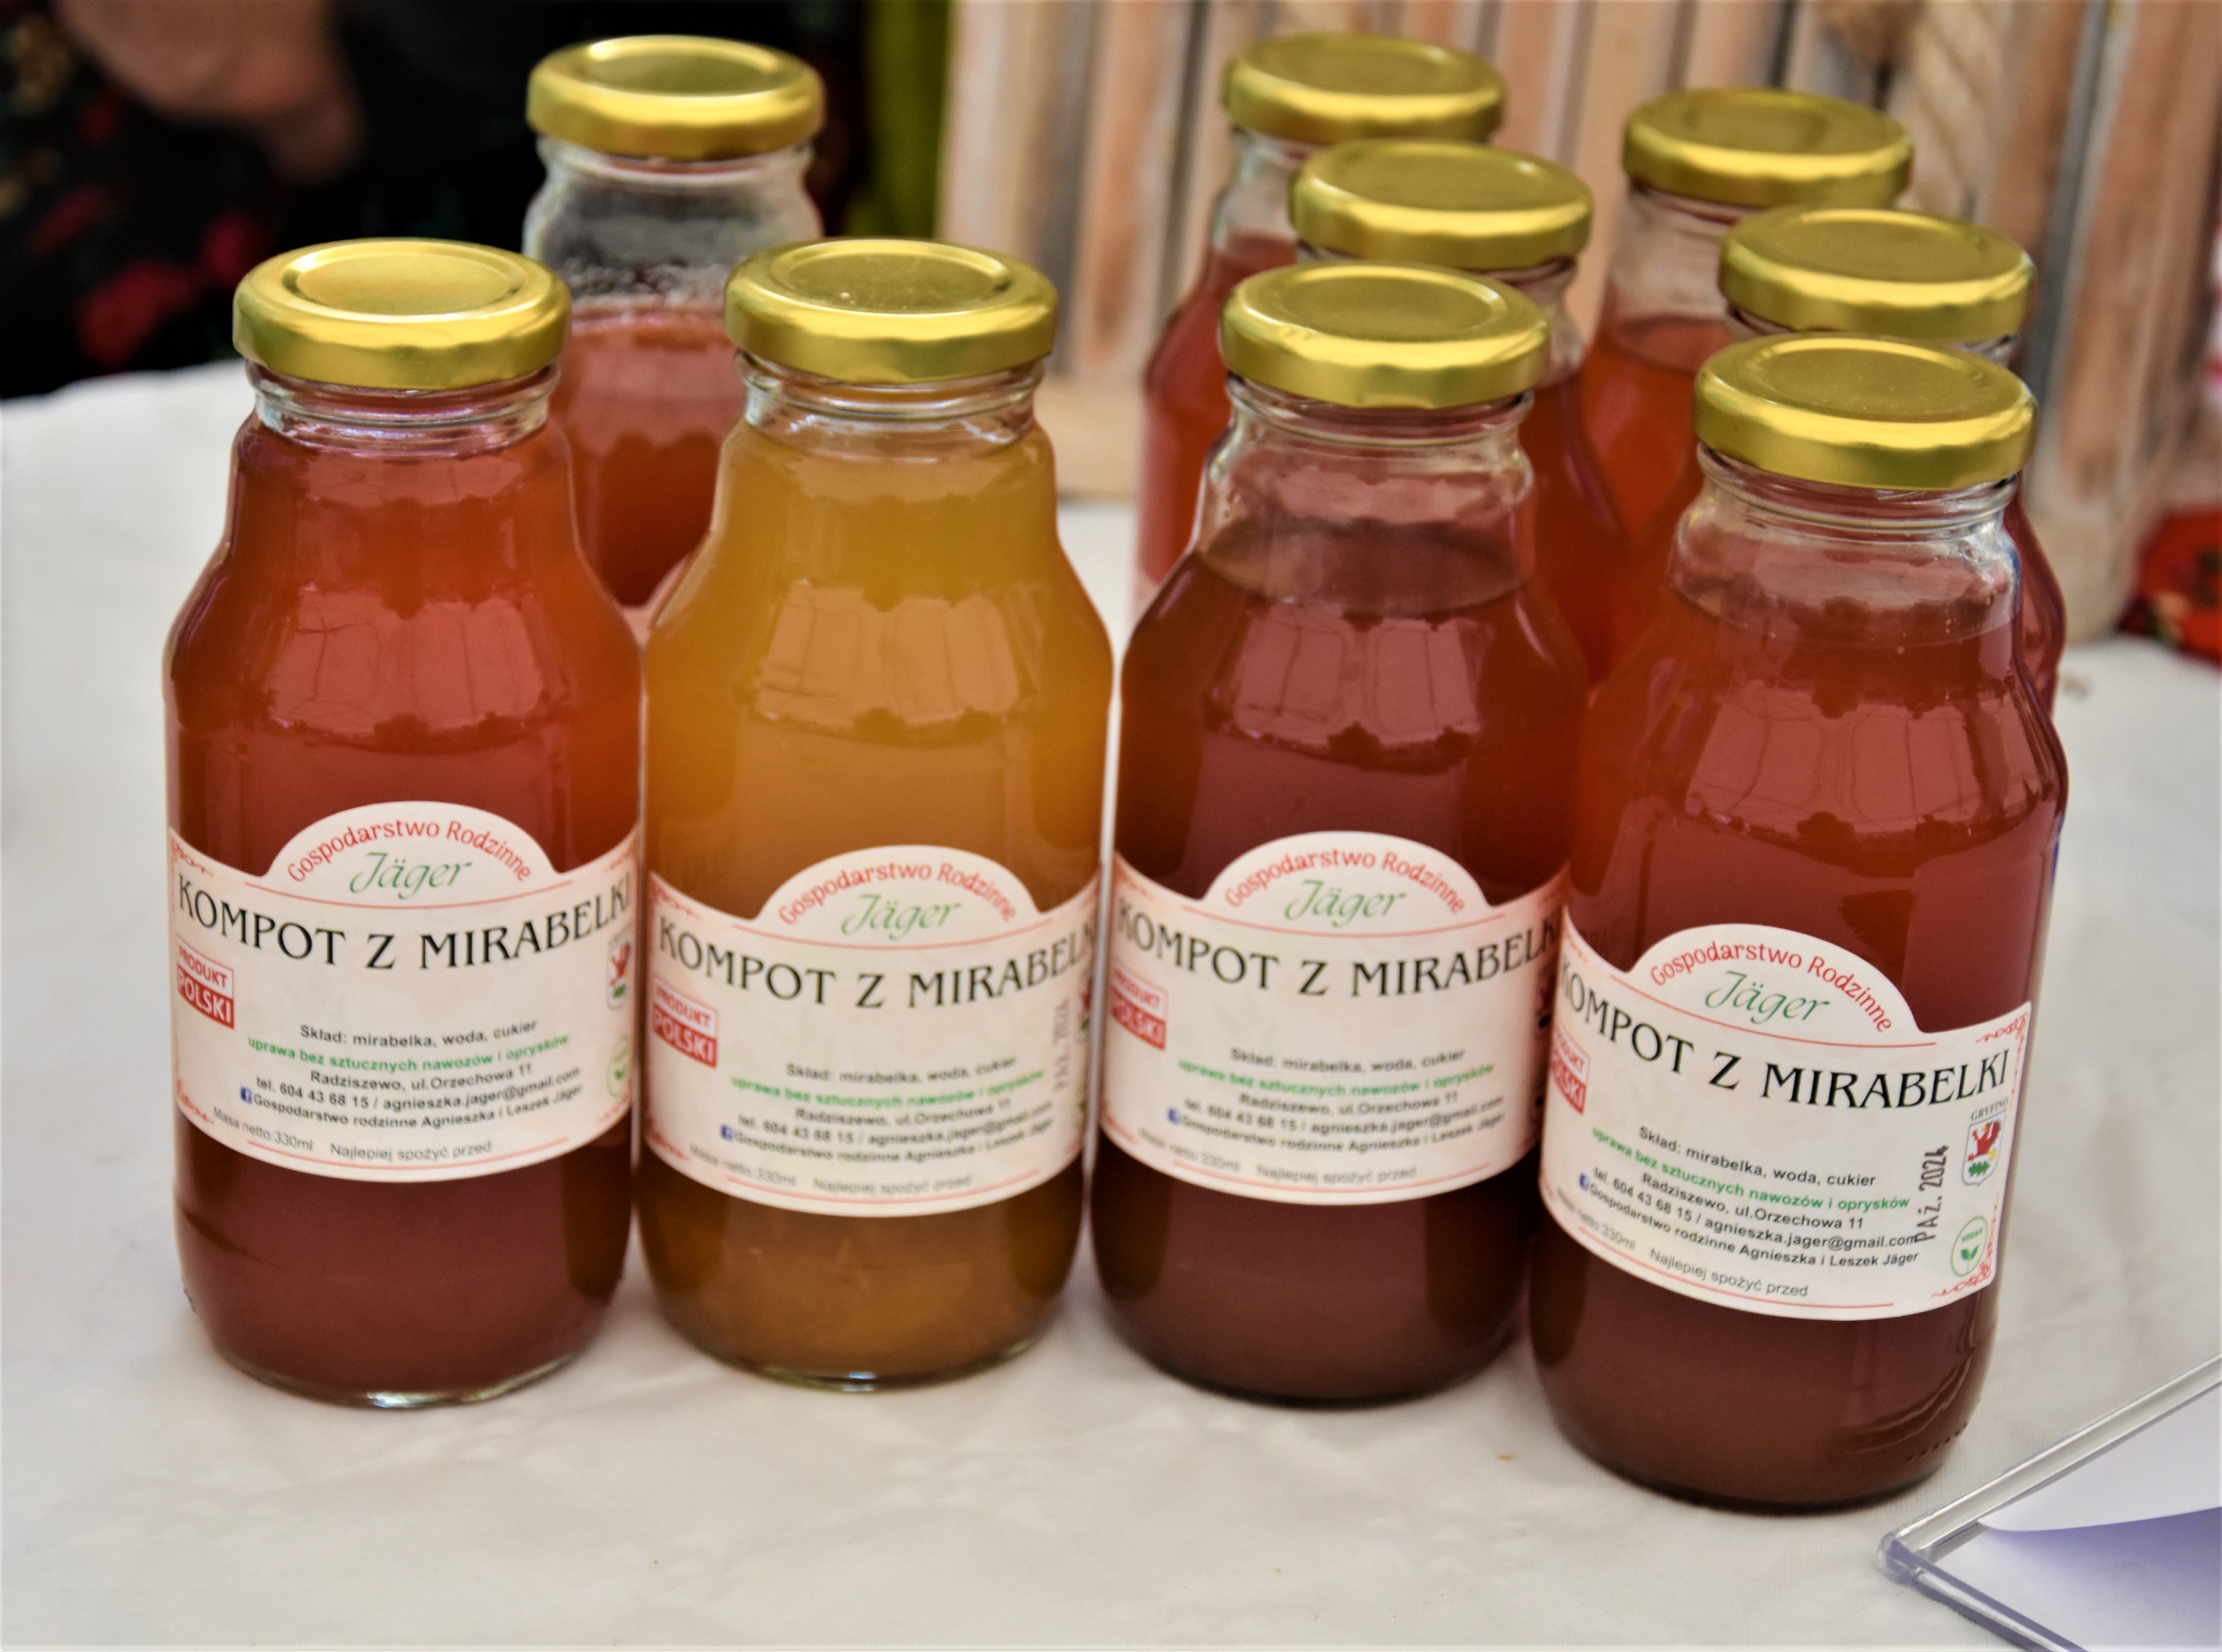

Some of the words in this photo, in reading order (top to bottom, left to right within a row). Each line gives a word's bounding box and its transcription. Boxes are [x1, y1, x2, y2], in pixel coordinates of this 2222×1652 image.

[287, 820, 439, 882] Gospodarstwo
[446, 820, 531, 881] Rodzinne
[349, 852, 472, 900] Jäger
[779, 862, 933, 925] Gospodarstwo
[937, 862, 1017, 922] Rodzinne
[1224, 848, 1376, 907] Gospodarstwo
[1382, 851, 1466, 914] Rodzinne
[1284, 879, 1407, 928] Jäger
[179, 874, 345, 965] KOMPOT
[365, 933, 397, 969] Z
[420, 871, 630, 970] MIRABELKI
[841, 893, 961, 940] Jäger
[179, 945, 228, 988] PRODUKT
[660, 916, 836, 1005] KOMPOT
[855, 972, 886, 1009] Z
[1118, 898, 1280, 990] KOMPOT
[1298, 960, 1329, 996] Z
[178, 968, 231, 1024] POLSKI
[1651, 941, 1802, 986] Gospodarstwo
[1807, 955, 1891, 1032] Rodzinne
[1705, 970, 1830, 1024] Jäger
[248, 1038, 296, 1058] uprawa
[300, 1049, 325, 1065] bez
[329, 1057, 417, 1073] sztucznych
[423, 1054, 493, 1071] nawozów
[497, 1050, 502, 1061] i
[505, 1035, 569, 1060] oprysków
[300, 1025, 346, 1044] Skład:
[353, 1033, 436, 1048] mirabelka,
[442, 1030, 487, 1045] woda,
[493, 1020, 537, 1039] cukier
[256, 1076, 274, 1092] tel.
[280, 1084, 303, 1098] 604
[308, 1090, 324, 1103] 43
[329, 1093, 346, 1106] 68
[352, 1096, 369, 1109] 15
[383, 1067, 580, 1112] agnieszka.jager@gmail.com
[310, 1070, 405, 1091] Radziszewo,
[411, 1067, 513, 1090] ul.Orzechowa
[519, 1063, 532, 1076] 11
[1708, 1050, 1742, 1091] Z
[1760, 1048, 2010, 1109] MIRABELKI
[253, 1093, 348, 1125] Gospodarstwo
[353, 1115, 417, 1128] rodzinne
[421, 1109, 495, 1130] Agnieszka
[506, 1096, 549, 1116] Leszek
[1971, 1096, 2009, 1121] GRYFINO
[331, 1143, 392, 1161] Najlepiej
[397, 1146, 448, 1162] spożyć
[453, 1140, 492, 1159] przed
[1592, 1126, 1633, 1157] uprawa
[1635, 1149, 1659, 1169] bez
[1662, 1163, 1744, 1196] sztucznych
[1749, 1188, 1824, 1208] nawozów
[1828, 1197, 1833, 1209] i
[1837, 1196, 1910, 1213] oprysków
[1639, 1125, 1681, 1154] Skład:
[1685, 1148, 1767, 1179] mirabelka,
[1773, 1168, 1820, 1186] woda,
[1827, 1173, 1877, 1186] cukier
[1919, 1144, 1949, 1192] 2024
[1589, 1182, 1672, 1233] Gospodarstwo
[1674, 1227, 1736, 1253] rodzinne
[1739, 1244, 1817, 1265] Agnieszka
[1820, 1254, 1825, 1266] i
[1829, 1255, 1879, 1267] Leszek
[1882, 1252, 1920, 1267] Jäger
[1613, 1178, 1634, 1198] 604
[1637, 1191, 1653, 1206] 43
[1656, 1198, 1672, 1215] 68
[1676, 1206, 1693, 1222] 15
[1695, 1213, 1703, 1225] /
[1705, 1217, 1918, 1251] agnieszka.jager@gmail.com
[1643, 1172, 1729, 1215] Radziszewo,
[1735, 1206, 1843, 1229] ul.Orzechowa
[1849, 1218, 1864, 1229] 11
[1649, 1247, 1707, 1281] Najlepiej
[1711, 1270, 1763, 1292] spożyć
[1766, 1281, 1809, 1297] przed
